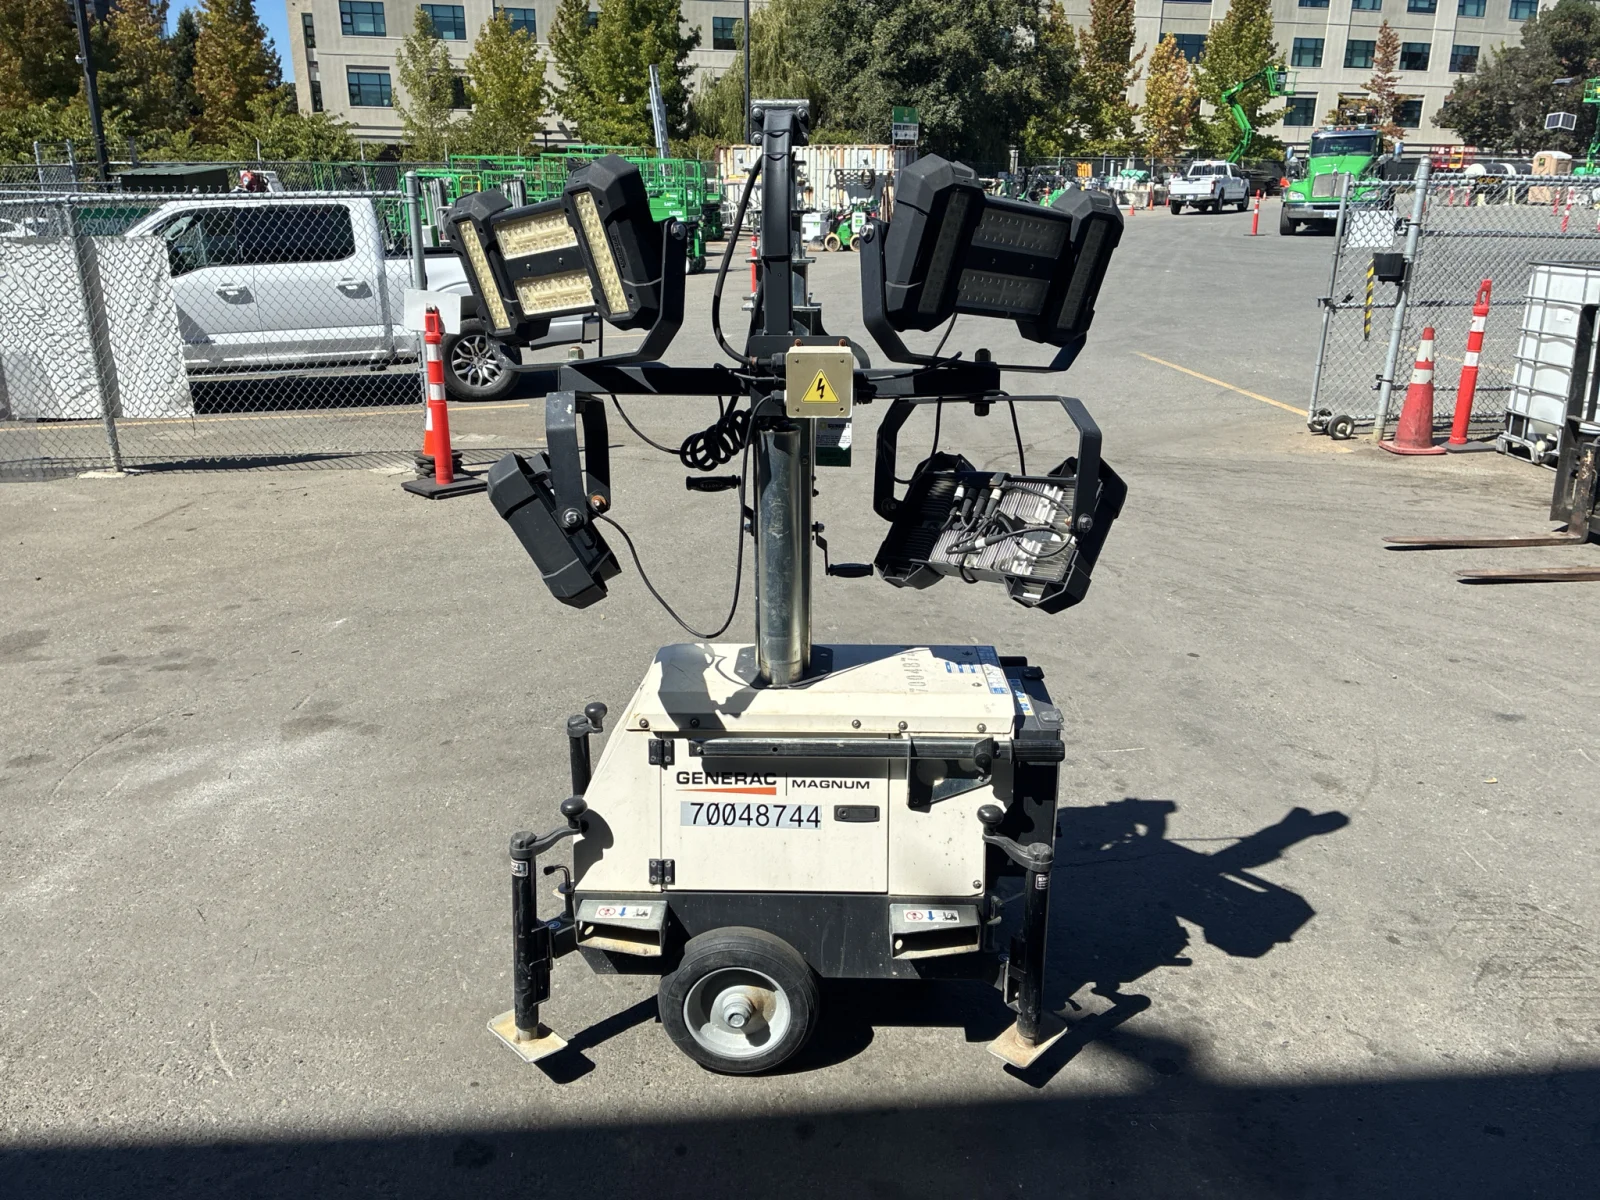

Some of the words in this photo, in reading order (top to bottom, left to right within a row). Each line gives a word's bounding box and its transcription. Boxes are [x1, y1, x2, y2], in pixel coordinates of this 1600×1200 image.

[676, 771, 777, 786] GENERAC
[791, 779, 870, 790] MAGNUM
[690, 802, 821, 828] 70048744
